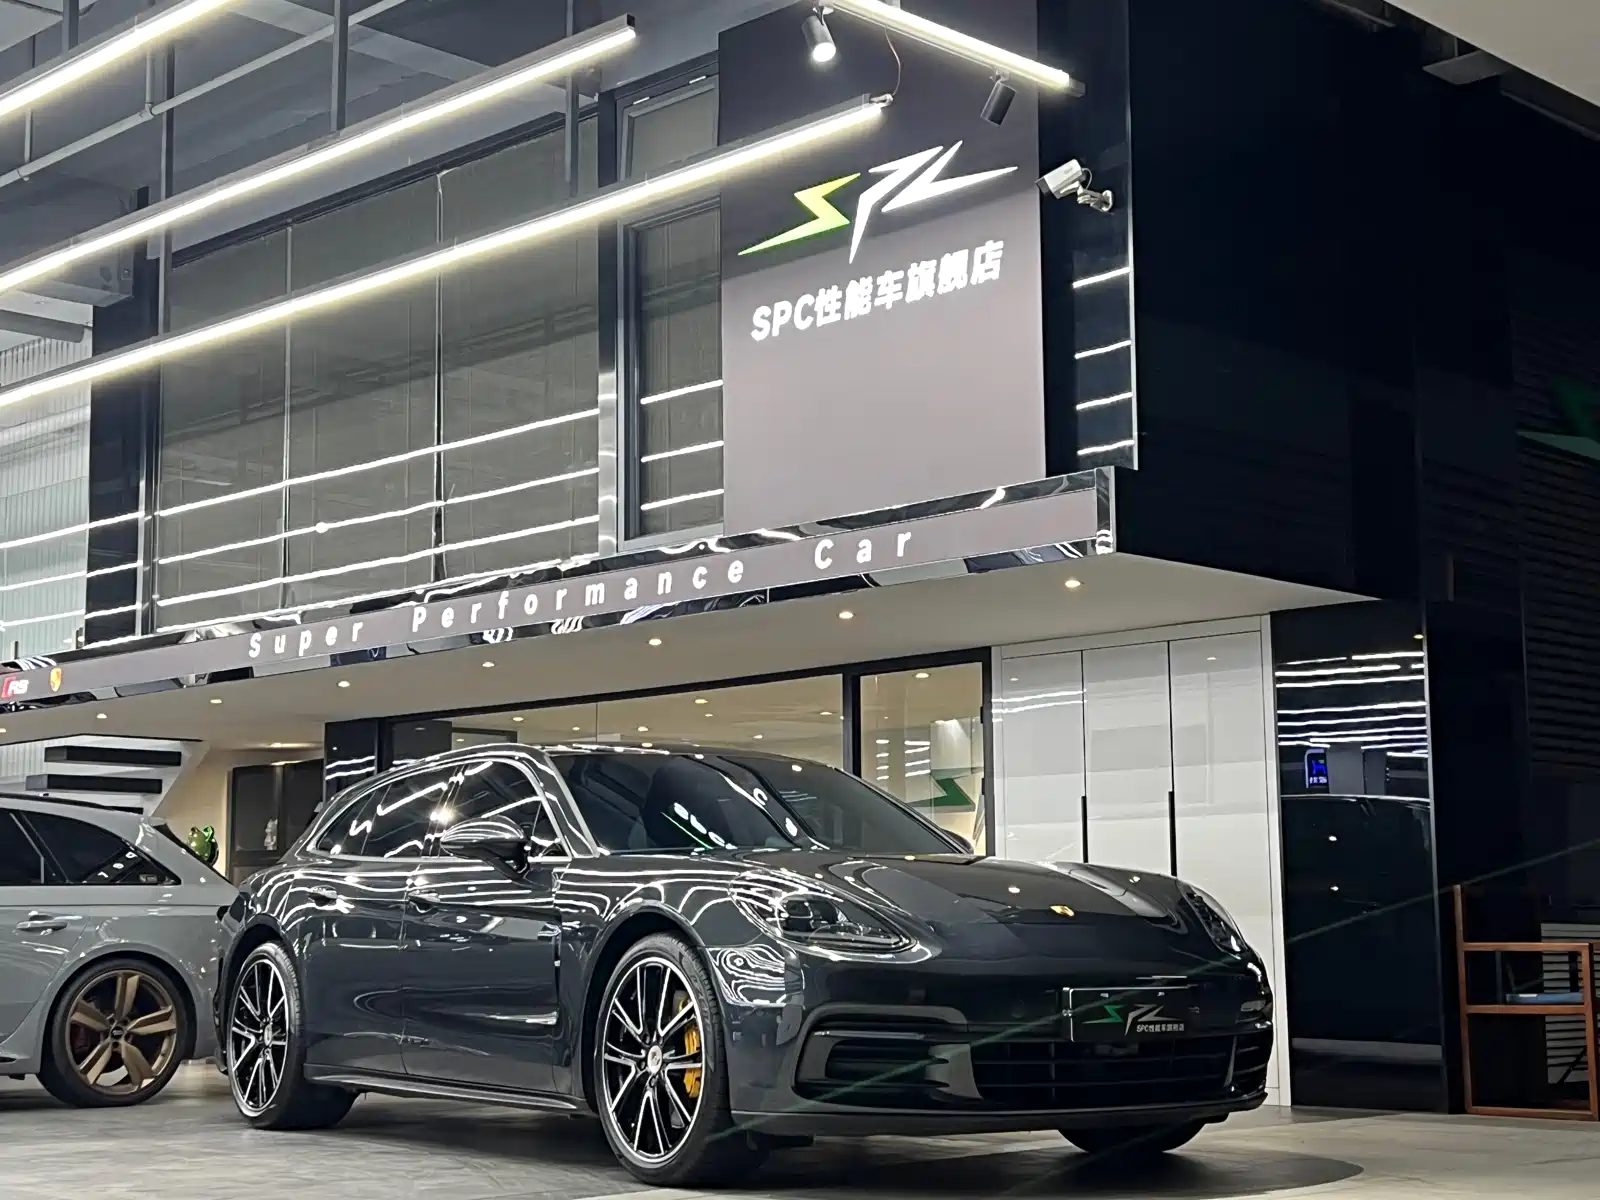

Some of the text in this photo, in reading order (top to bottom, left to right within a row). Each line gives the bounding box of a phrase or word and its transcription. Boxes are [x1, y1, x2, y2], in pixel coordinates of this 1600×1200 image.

[751, 240, 1004, 341] SPC性能车旗舰店
[248, 531, 912, 658] Super Performance Car
